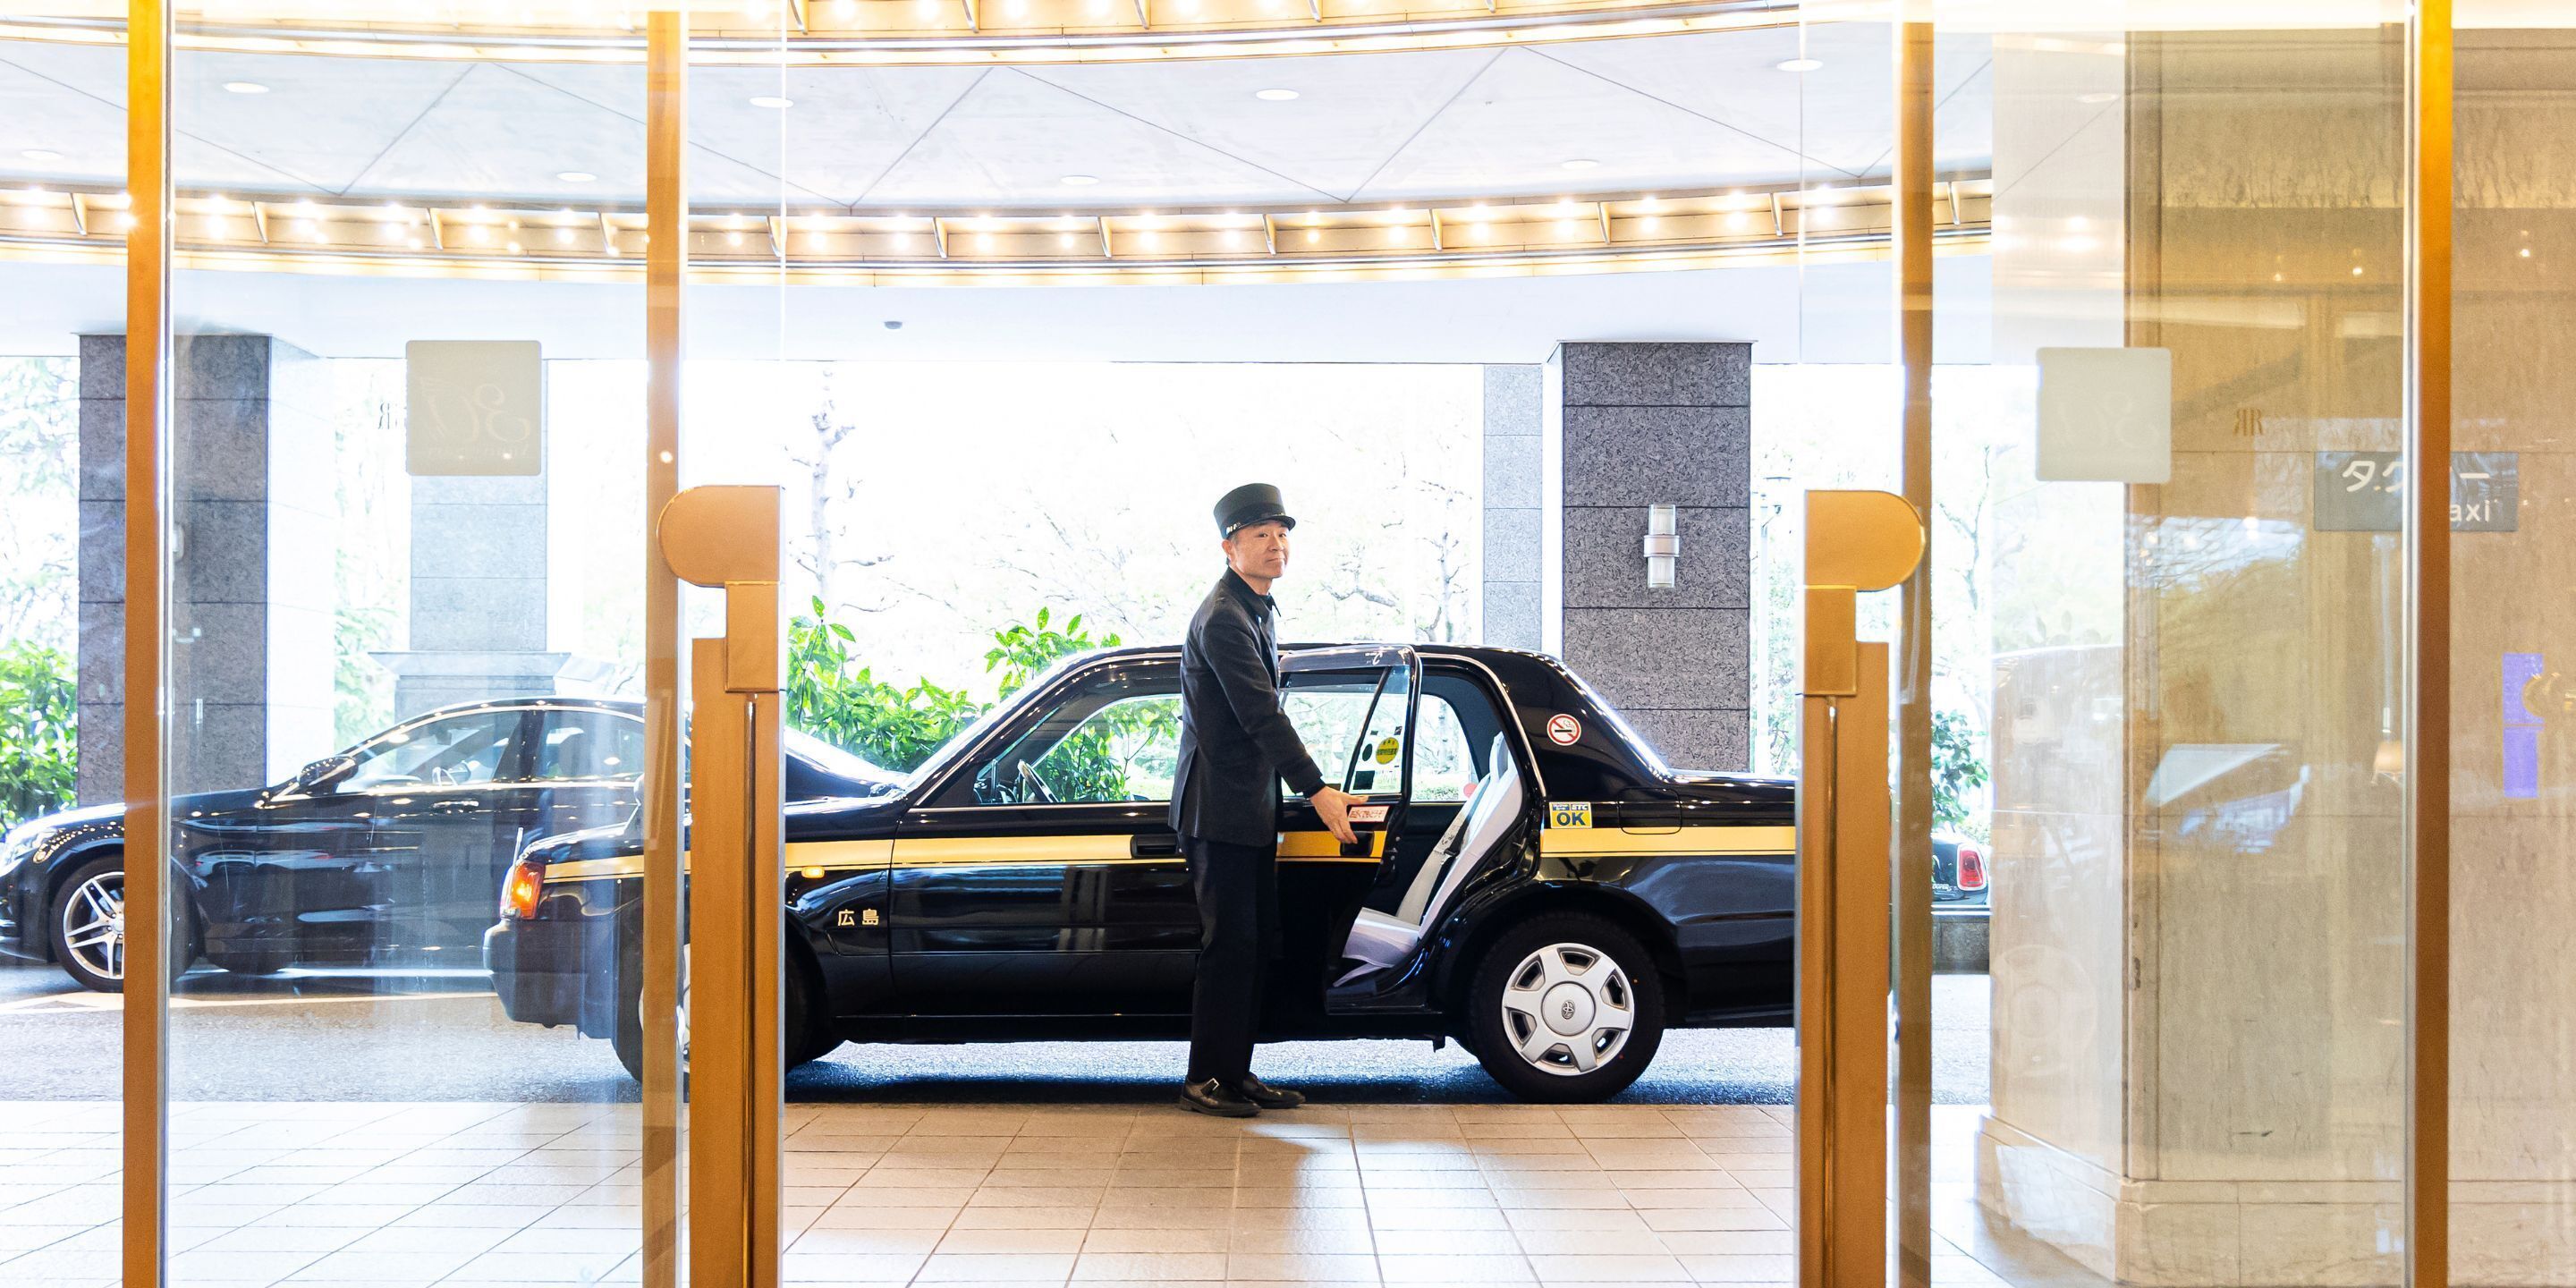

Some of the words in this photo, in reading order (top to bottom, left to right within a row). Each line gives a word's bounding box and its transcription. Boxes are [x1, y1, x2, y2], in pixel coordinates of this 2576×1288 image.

[2343, 461, 2490, 493] タクー
[2450, 499, 2490, 522] axi
[1557, 812, 1586, 826] OK
[838, 909, 879, 926] 広島
